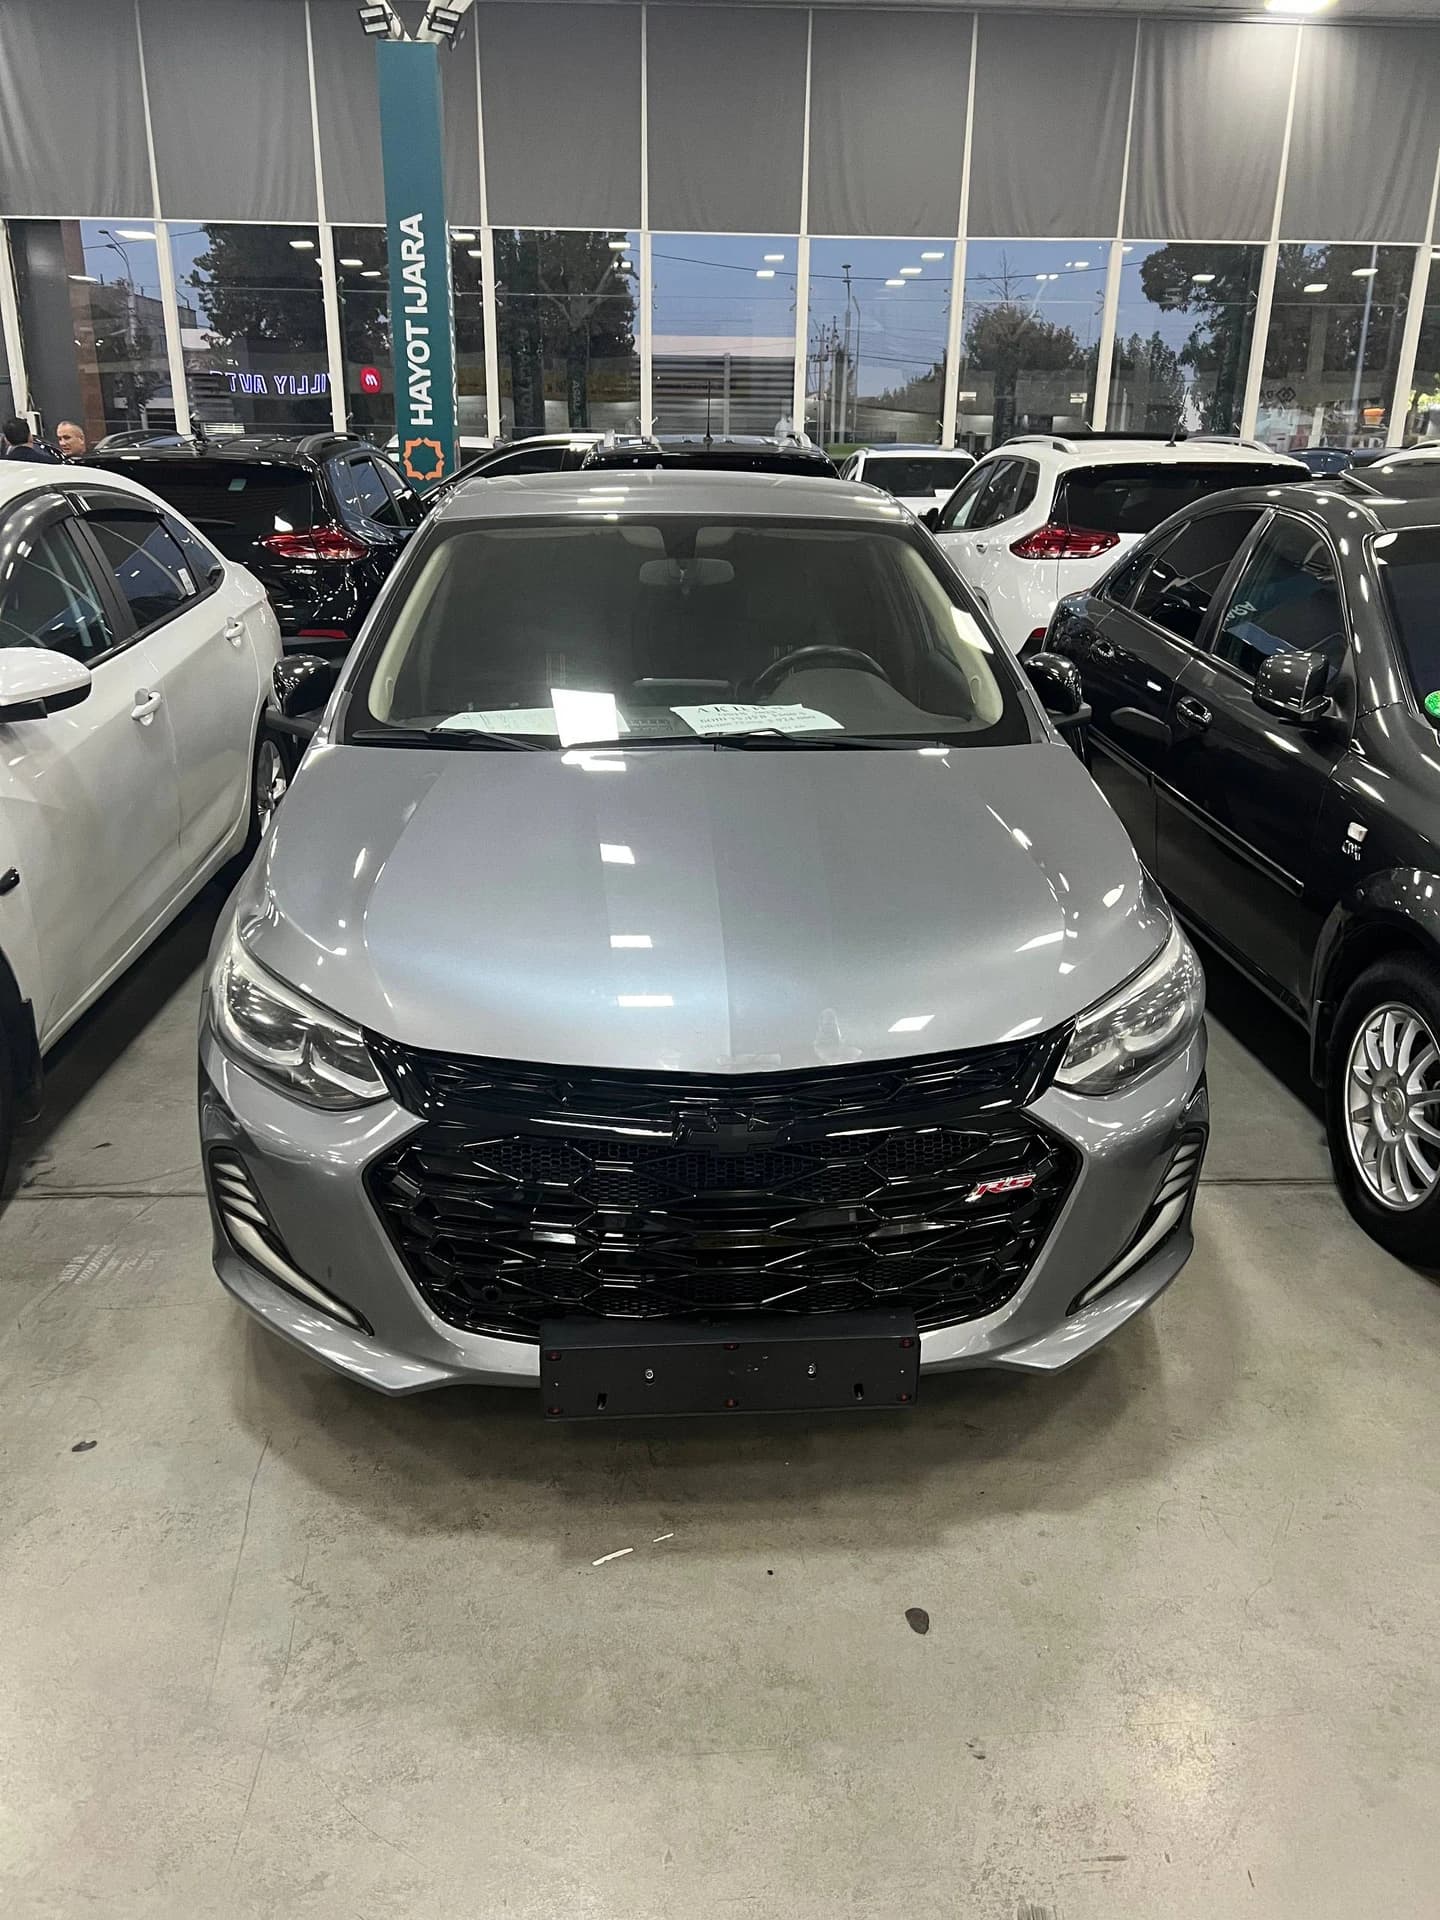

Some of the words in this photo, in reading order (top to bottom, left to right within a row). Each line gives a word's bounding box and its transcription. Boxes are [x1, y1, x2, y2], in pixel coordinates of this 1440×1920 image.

[400, 213, 428, 314] IJARA
[405, 320, 433, 426] HAYOT
[964, 1173, 1037, 1202] RS
